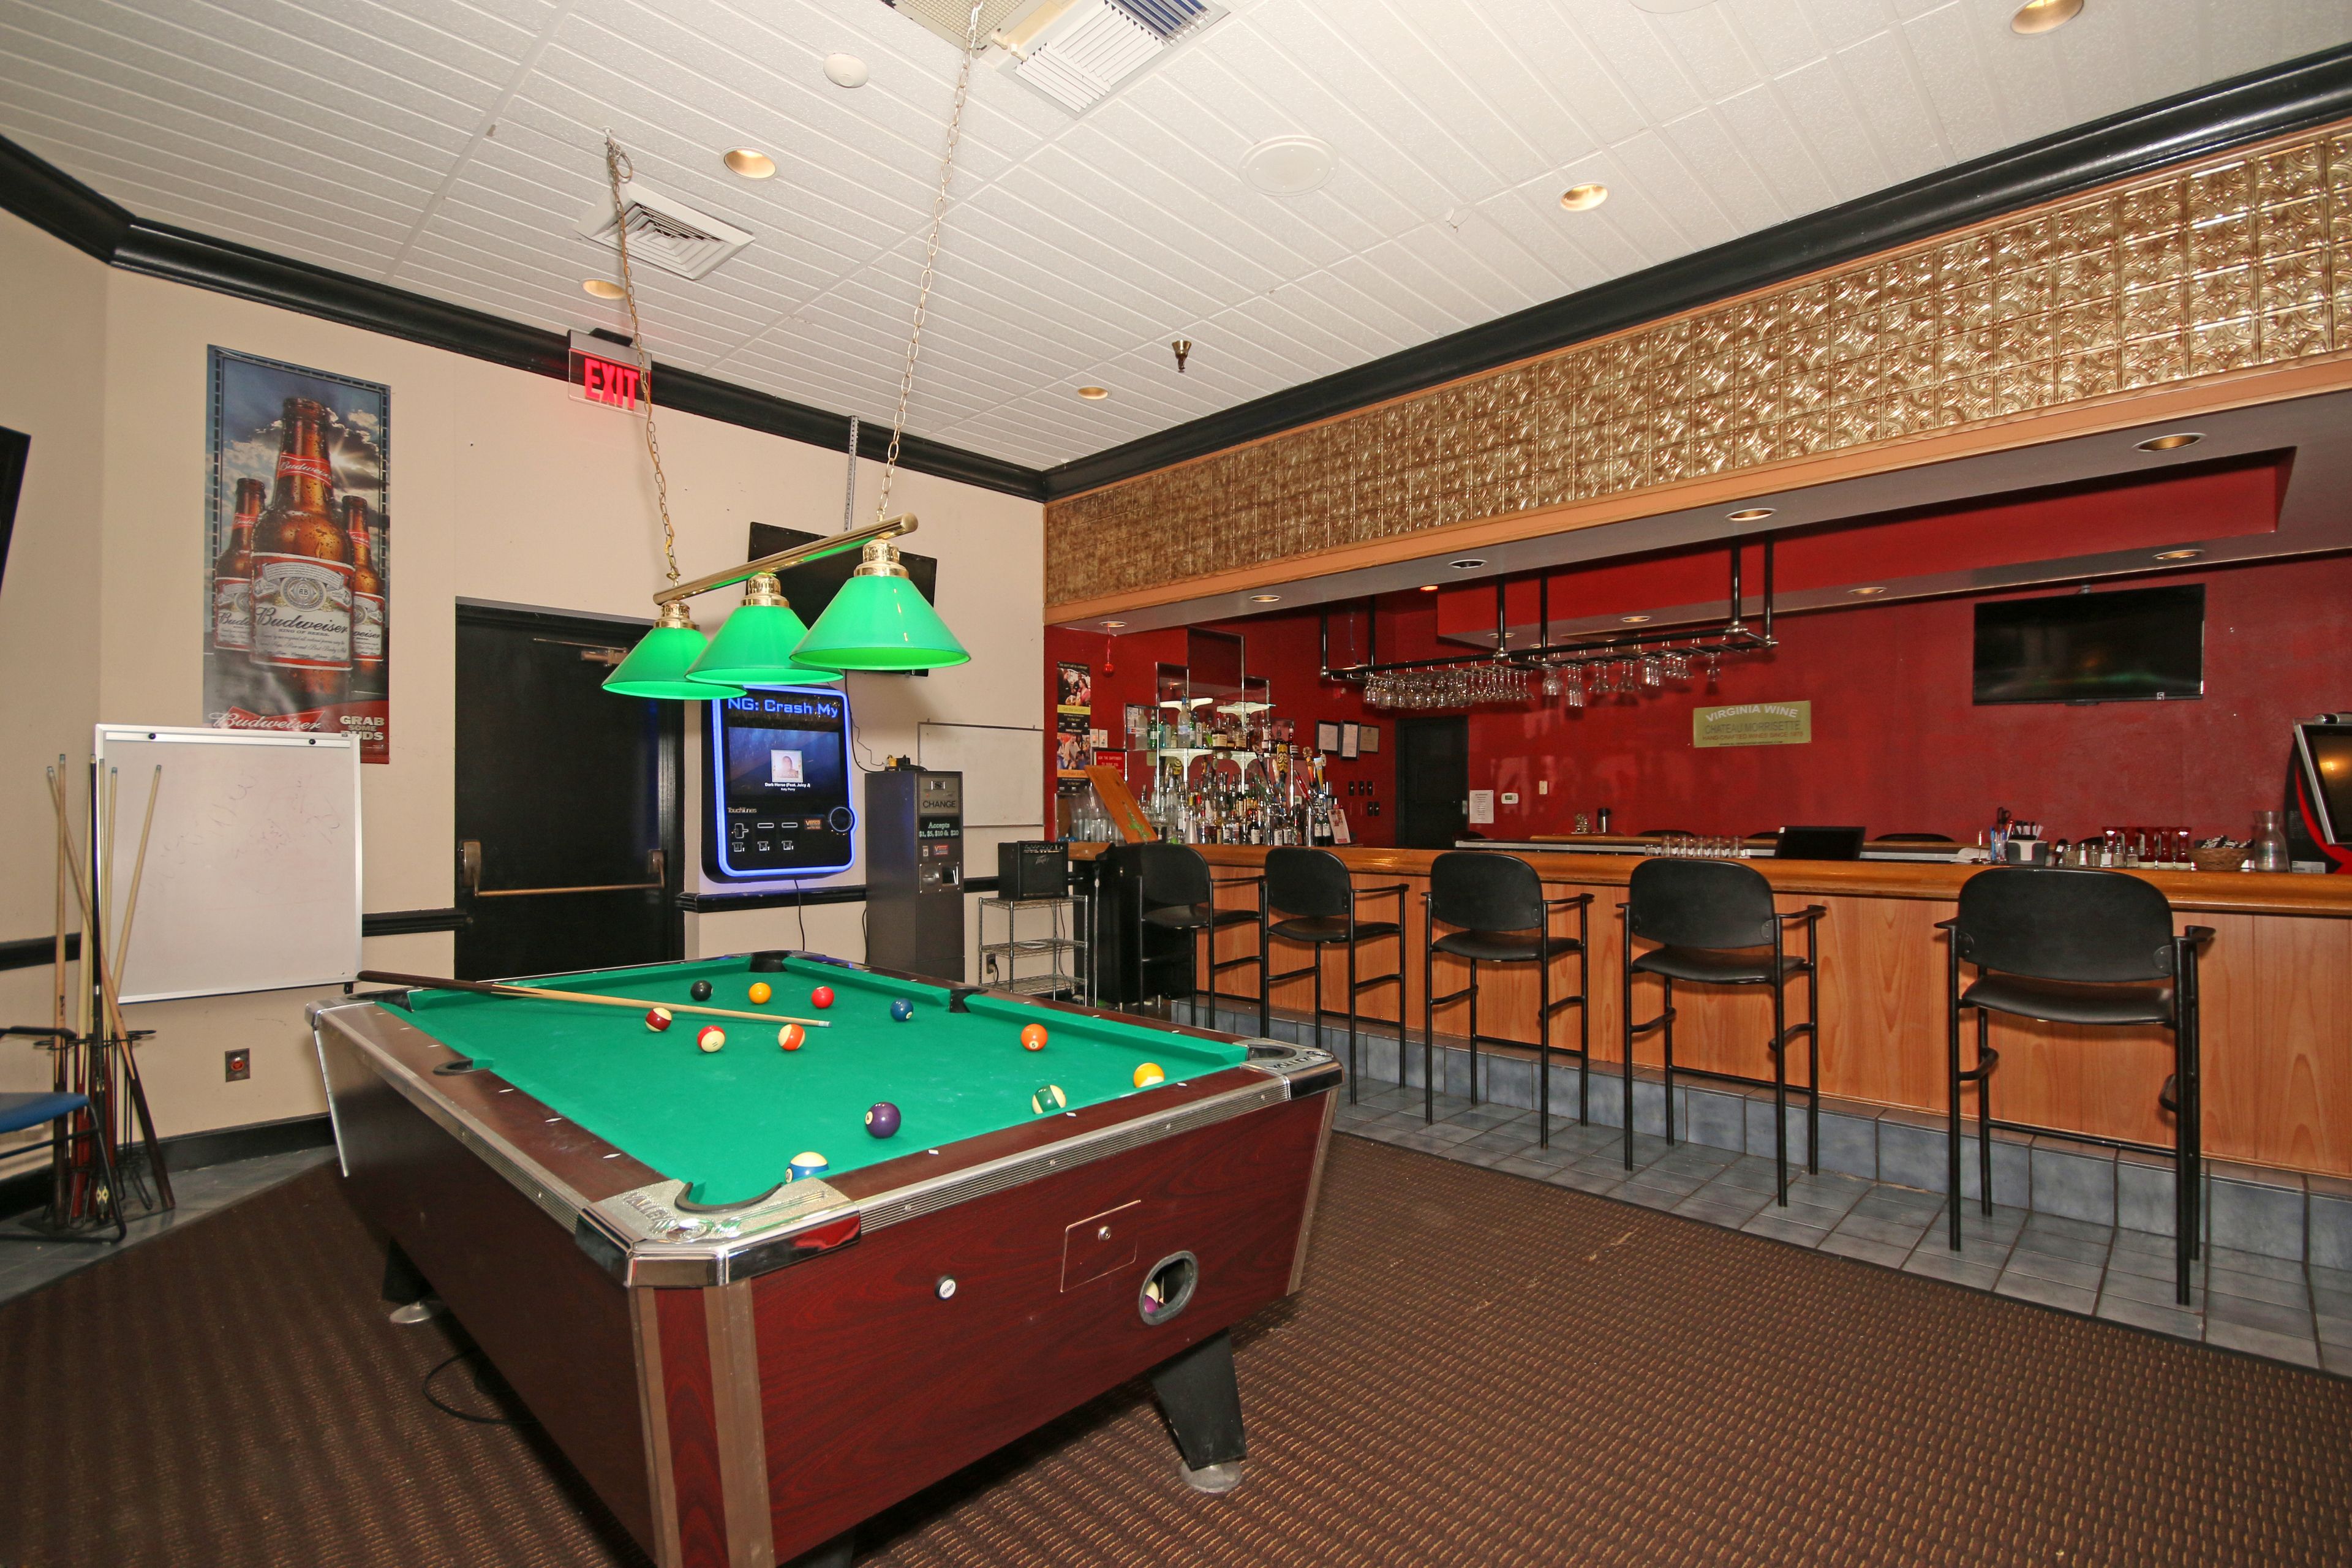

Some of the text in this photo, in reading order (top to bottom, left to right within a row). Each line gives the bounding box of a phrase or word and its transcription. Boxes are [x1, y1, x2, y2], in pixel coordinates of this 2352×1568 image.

[584, 358, 639, 410] EXIT
[255, 606, 348, 633] Budweiser
[764, 699, 812, 714] Crash
[817, 703, 838, 718] My
[1706, 705, 1798, 722] VIRGINIA WINE
[208, 712, 322, 729] Budweiser
[339, 715, 385, 726] GRAB
[1705, 722, 1743, 734] CHATEAU
[922, 800, 956, 809] CHANGE
[928, 821, 950, 830] Accepts
[1265, 1056, 1310, 1071] VALLEY
[623, 1192, 677, 1223] VALLEY
[942, 1283, 954, 1295] START
